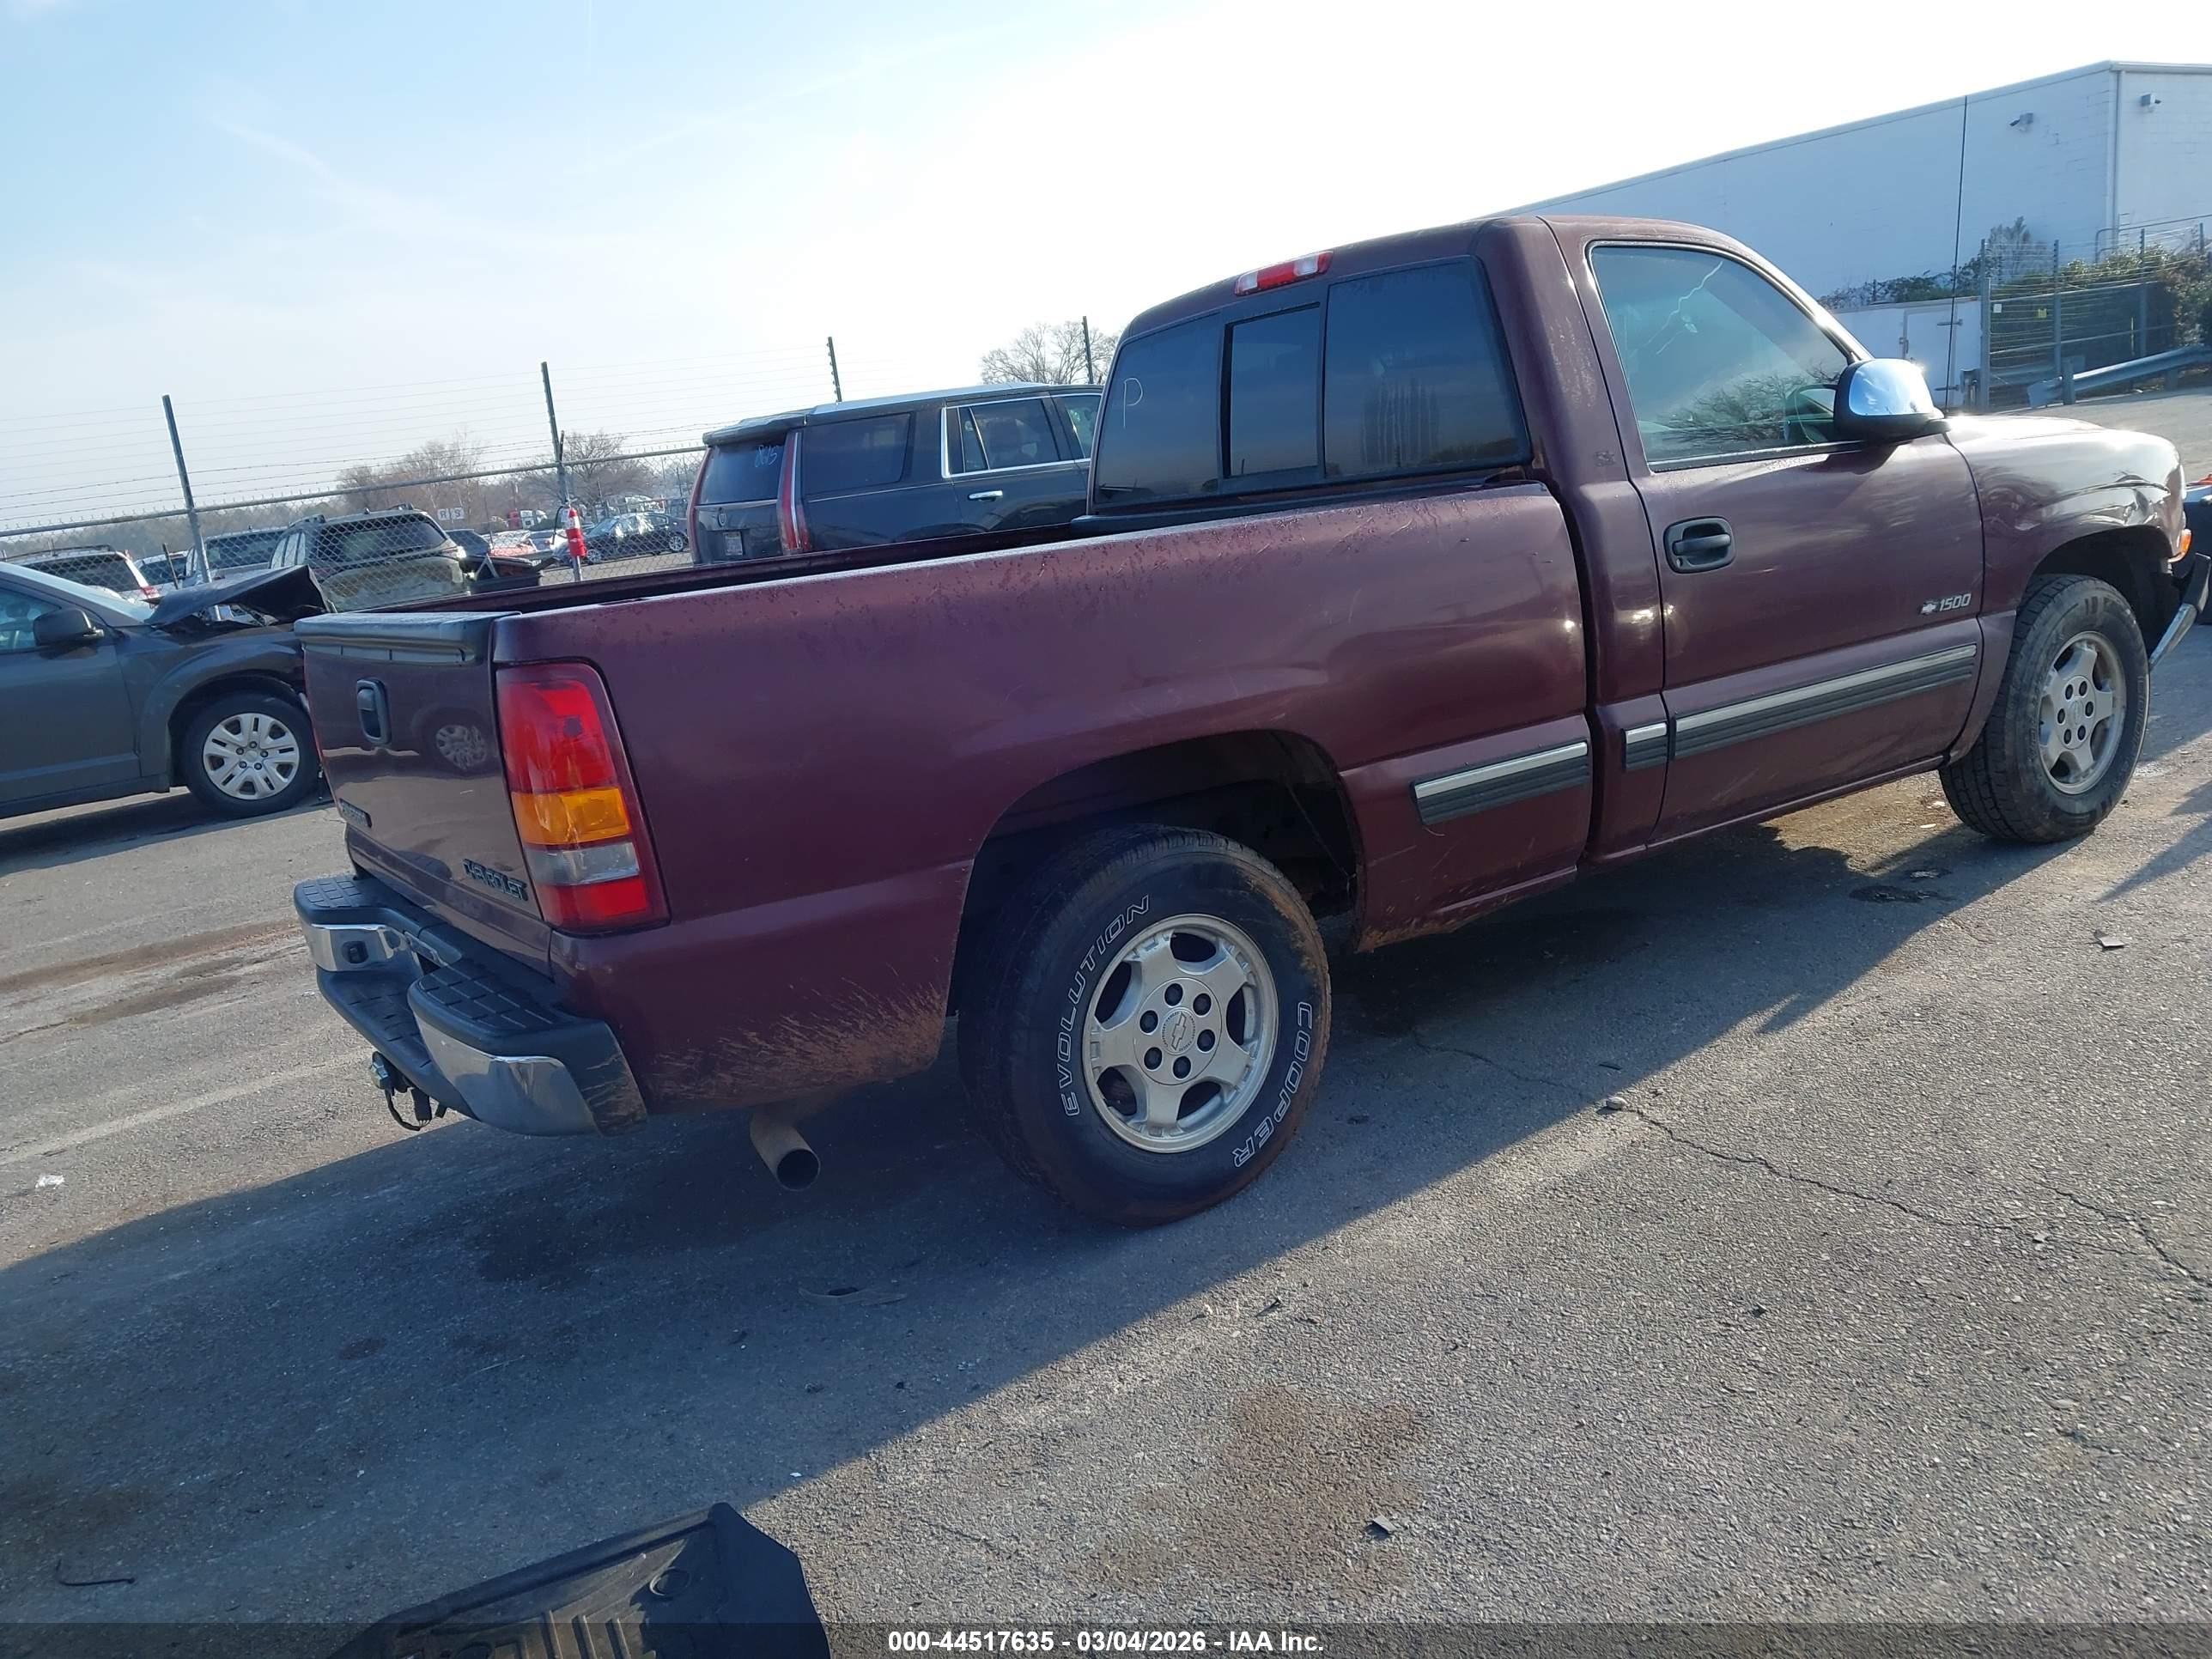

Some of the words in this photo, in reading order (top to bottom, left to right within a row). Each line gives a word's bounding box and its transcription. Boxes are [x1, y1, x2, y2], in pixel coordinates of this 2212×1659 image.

[1122, 377, 1144, 429] P
[1939, 592, 1972, 612] 1500
[1055, 894, 1150, 1116] EVOLUTION
[1231, 1001, 1313, 1169] COOPER
